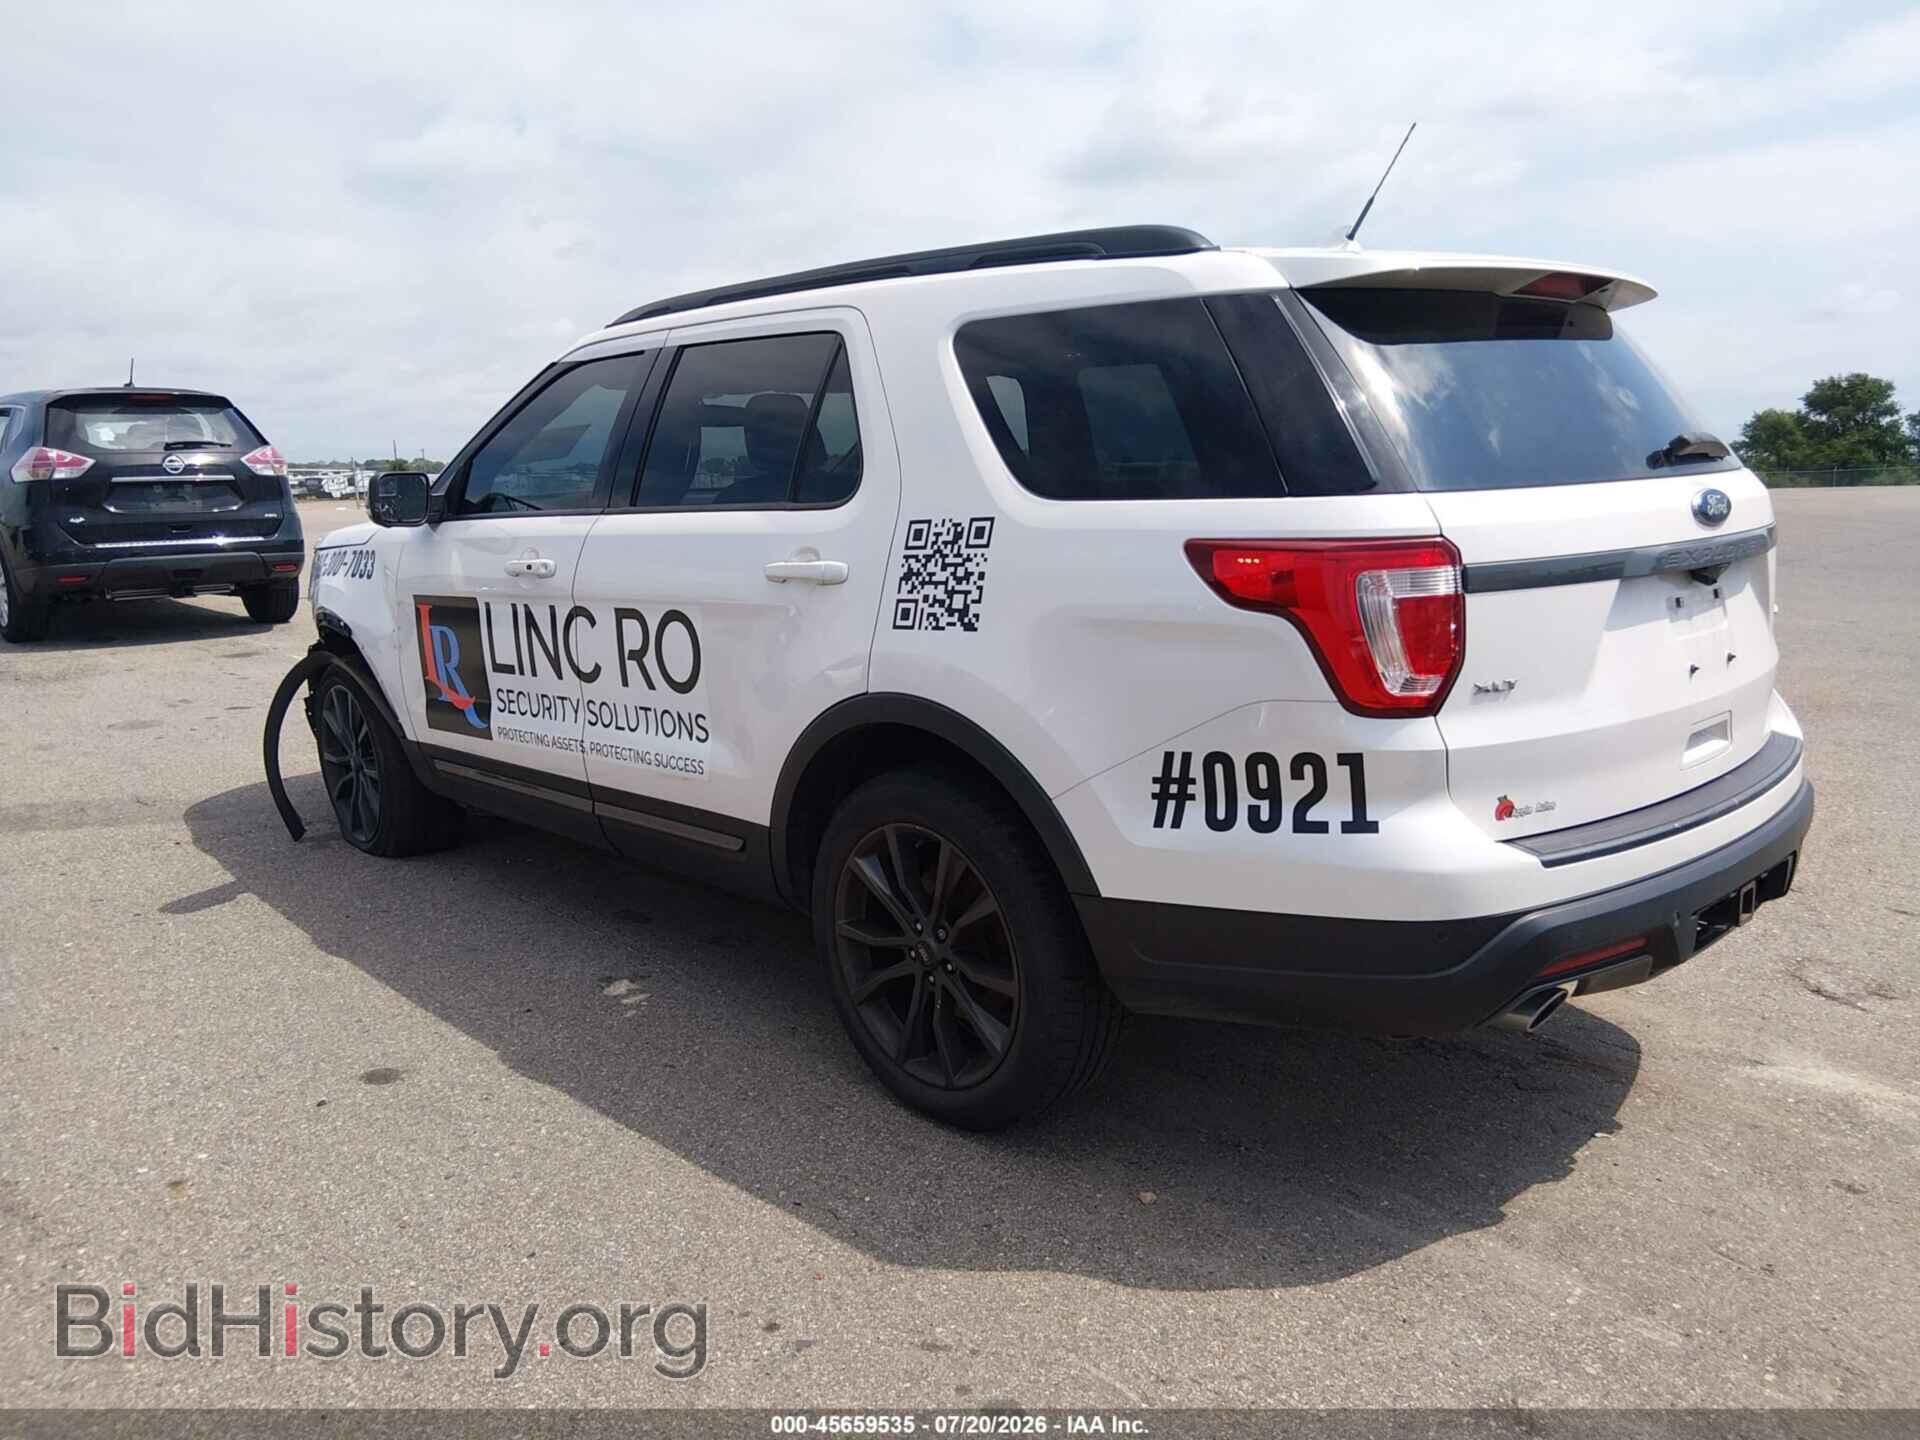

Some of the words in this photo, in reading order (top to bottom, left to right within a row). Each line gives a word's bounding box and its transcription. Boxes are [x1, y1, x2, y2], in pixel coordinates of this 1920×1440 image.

[484, 601, 602, 685] LINC
[614, 607, 702, 695] RO
[496, 687, 580, 724] SECURITY
[586, 699, 710, 744] SOLUTIONS
[497, 726, 550, 748] PROTECTING
[590, 741, 652, 766] PROTECTING
[654, 752, 705, 776] SUCCESS
[1151, 750, 1380, 834] #0921
